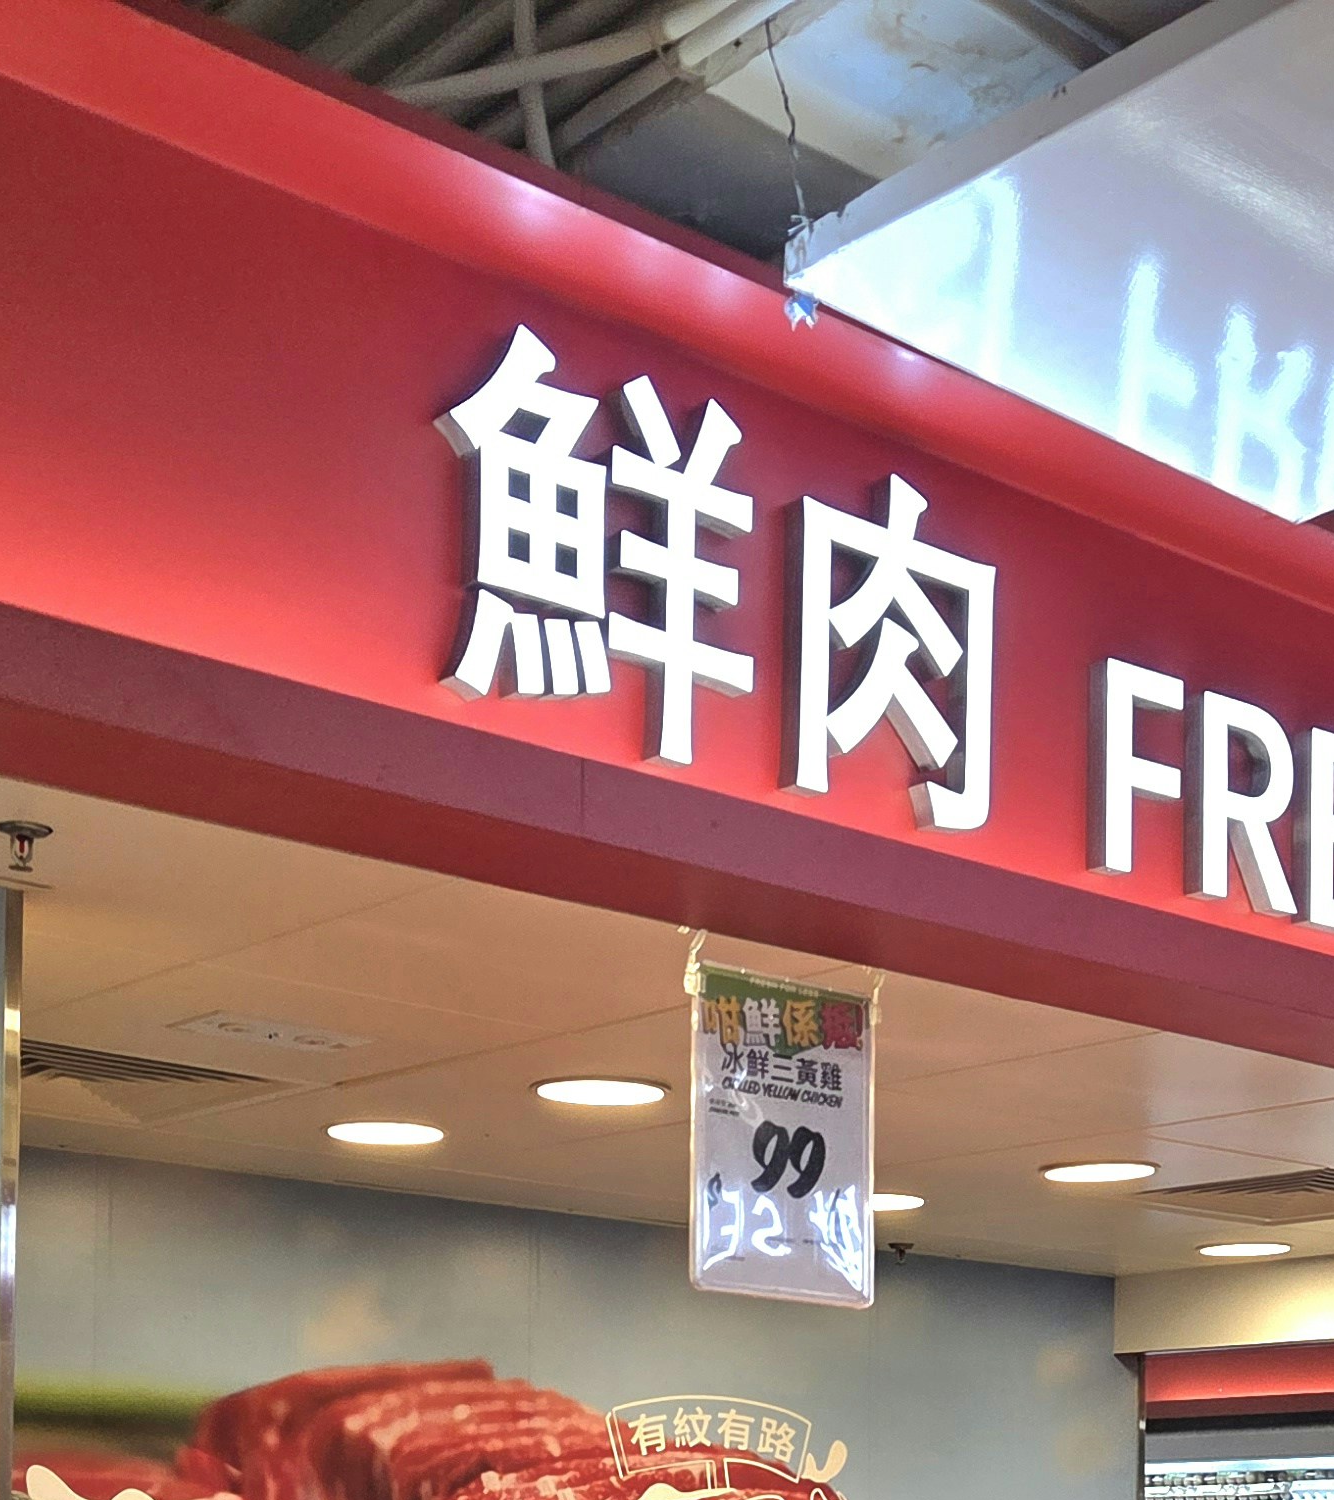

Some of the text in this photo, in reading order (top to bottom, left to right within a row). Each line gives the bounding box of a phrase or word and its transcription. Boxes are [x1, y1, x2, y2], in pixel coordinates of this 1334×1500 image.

[437, 323, 997, 832] 鮮肉
[627, 1406, 797, 1464] 有紋有路
